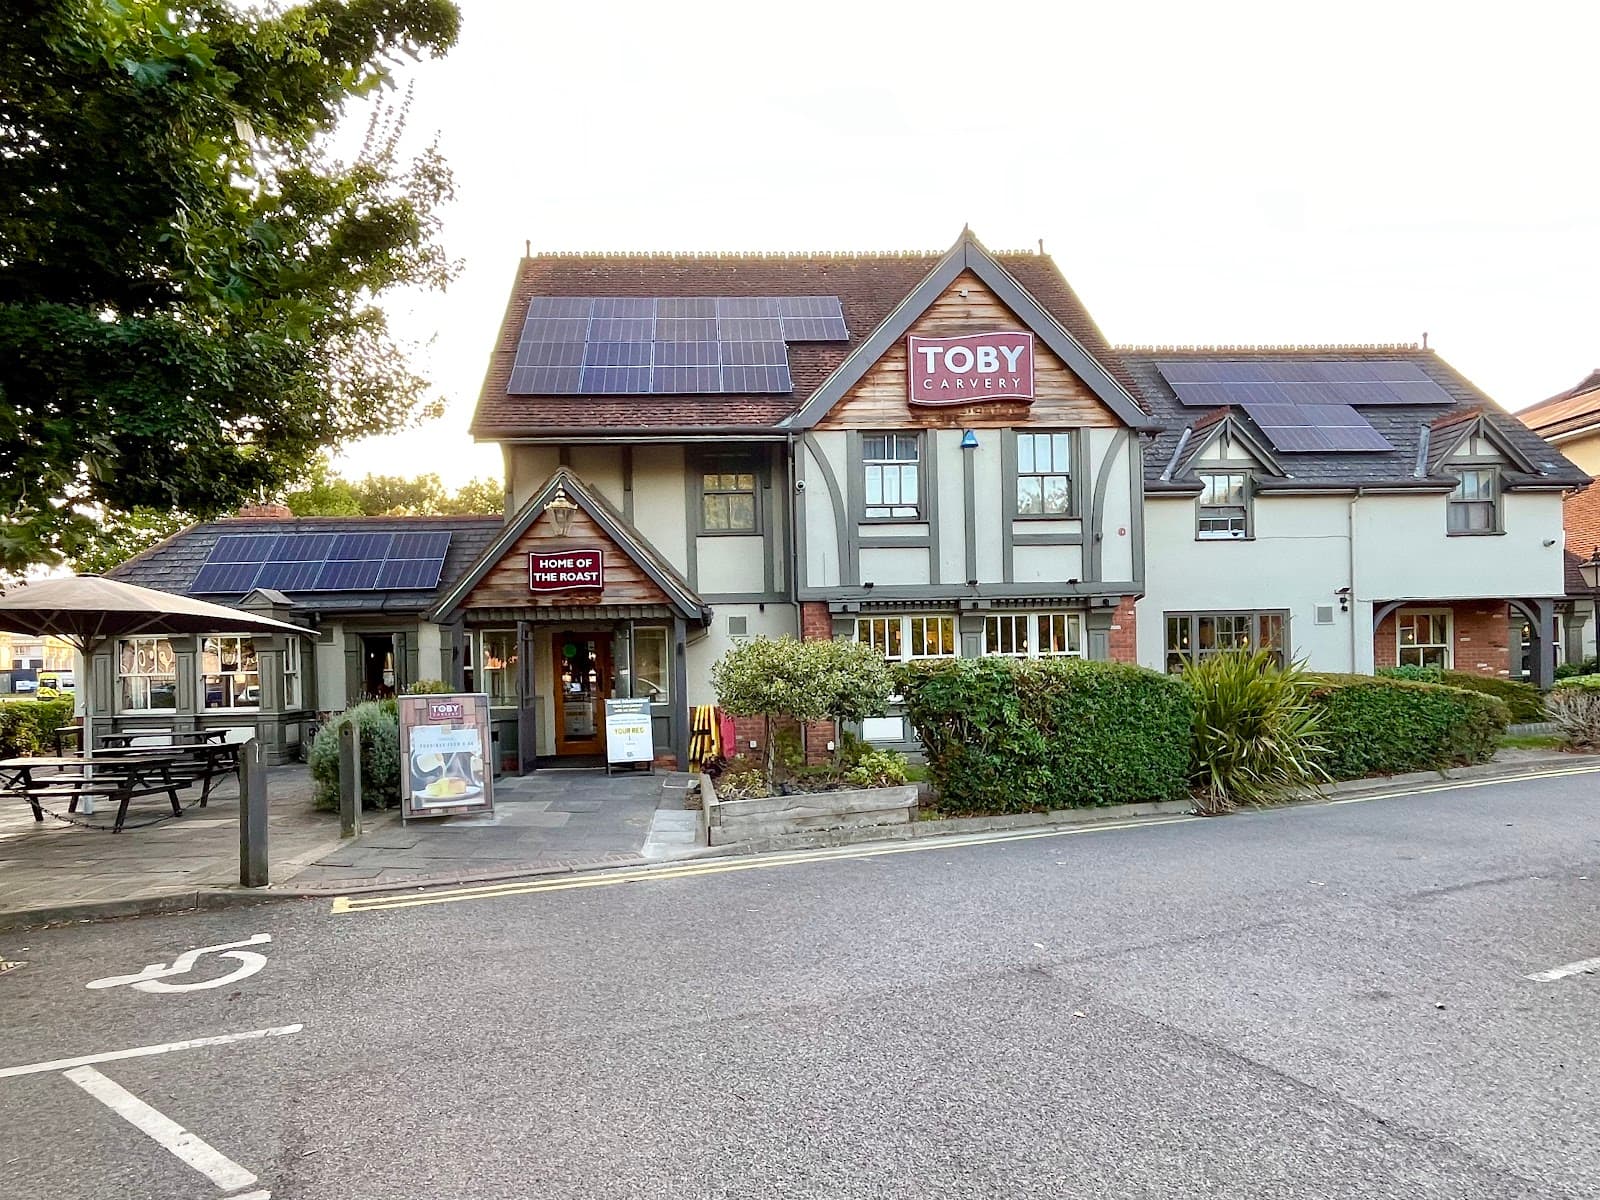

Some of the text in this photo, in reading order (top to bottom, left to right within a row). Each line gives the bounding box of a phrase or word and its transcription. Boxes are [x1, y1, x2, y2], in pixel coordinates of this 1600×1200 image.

[917, 345, 1025, 374] TOBY
[923, 378, 1021, 389] CARVERY
[539, 558, 593, 569] HOME OF
[533, 571, 598, 582] THE ROAST
[431, 704, 459, 713] TOBY
